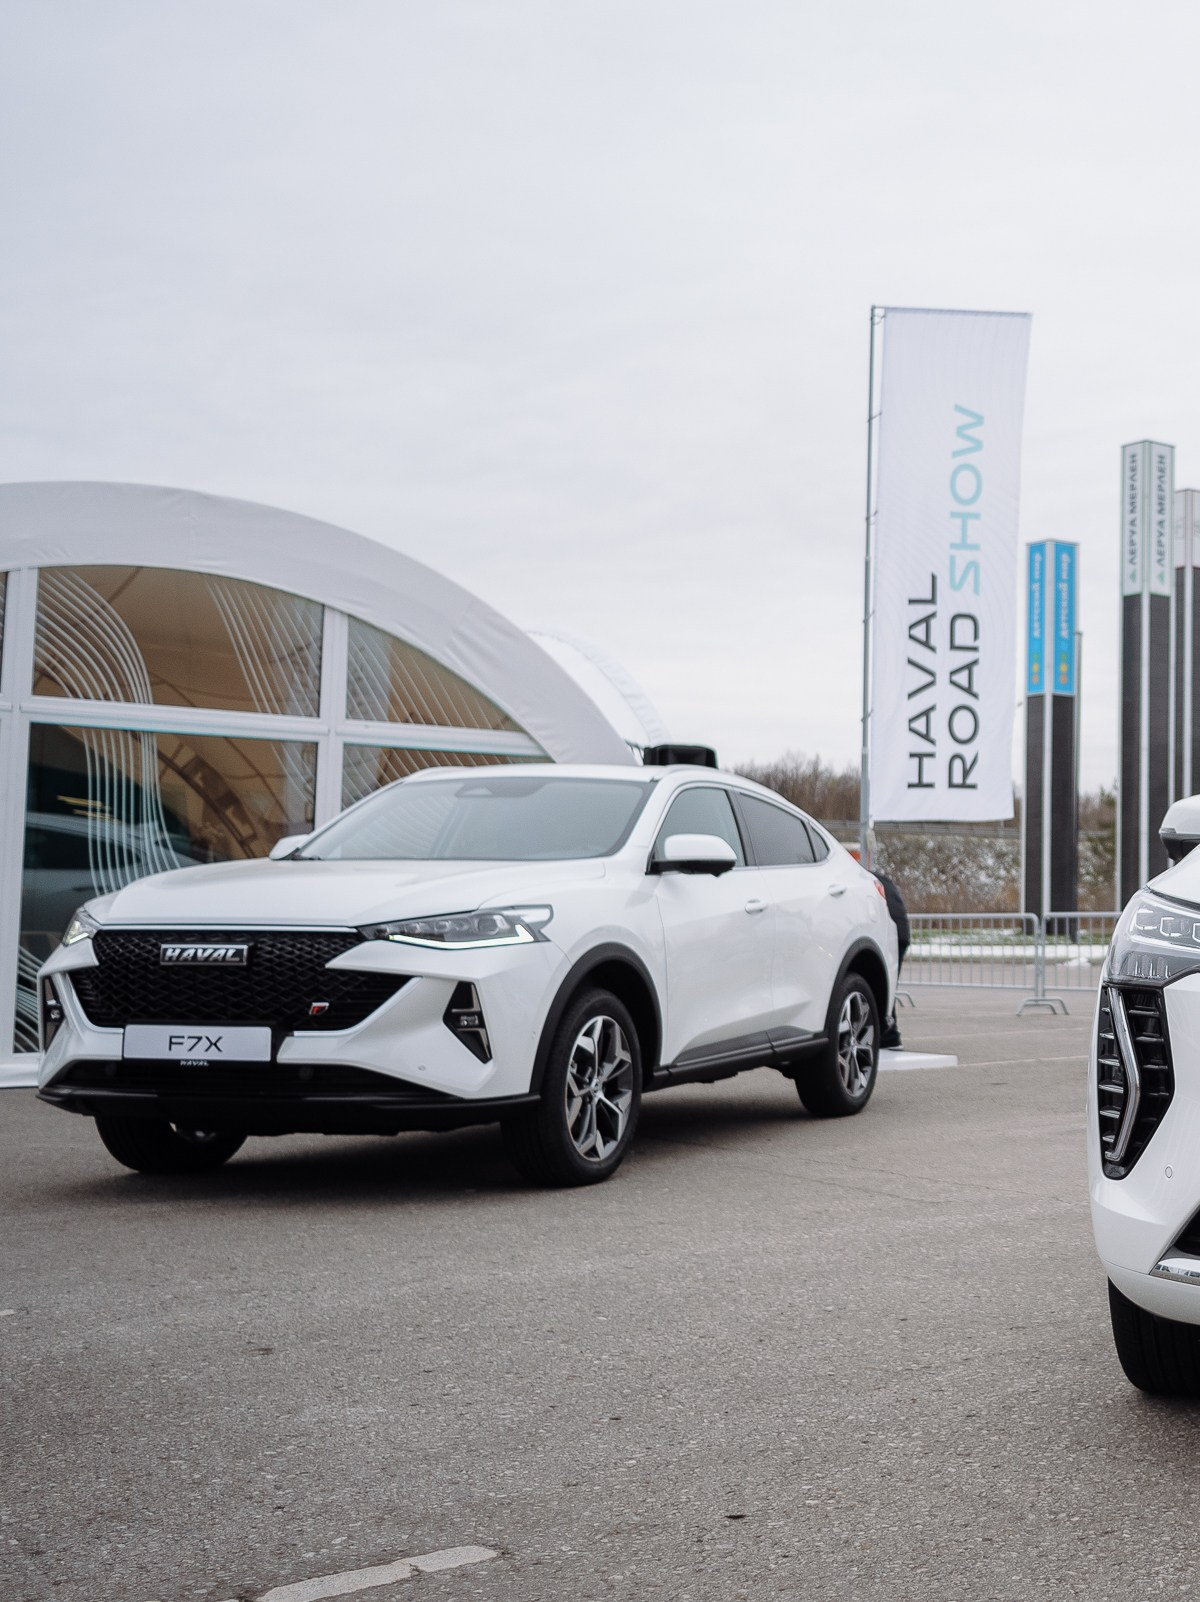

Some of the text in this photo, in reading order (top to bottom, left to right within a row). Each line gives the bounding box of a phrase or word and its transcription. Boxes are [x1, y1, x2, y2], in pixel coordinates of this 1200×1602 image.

[948, 403, 985, 790] ROAD SHOW
[907, 572, 937, 790] HAVAL
[163, 947, 241, 962] HAVAL
[167, 1034, 224, 1053] F7X
[179, 1059, 210, 1067] HAVAL
